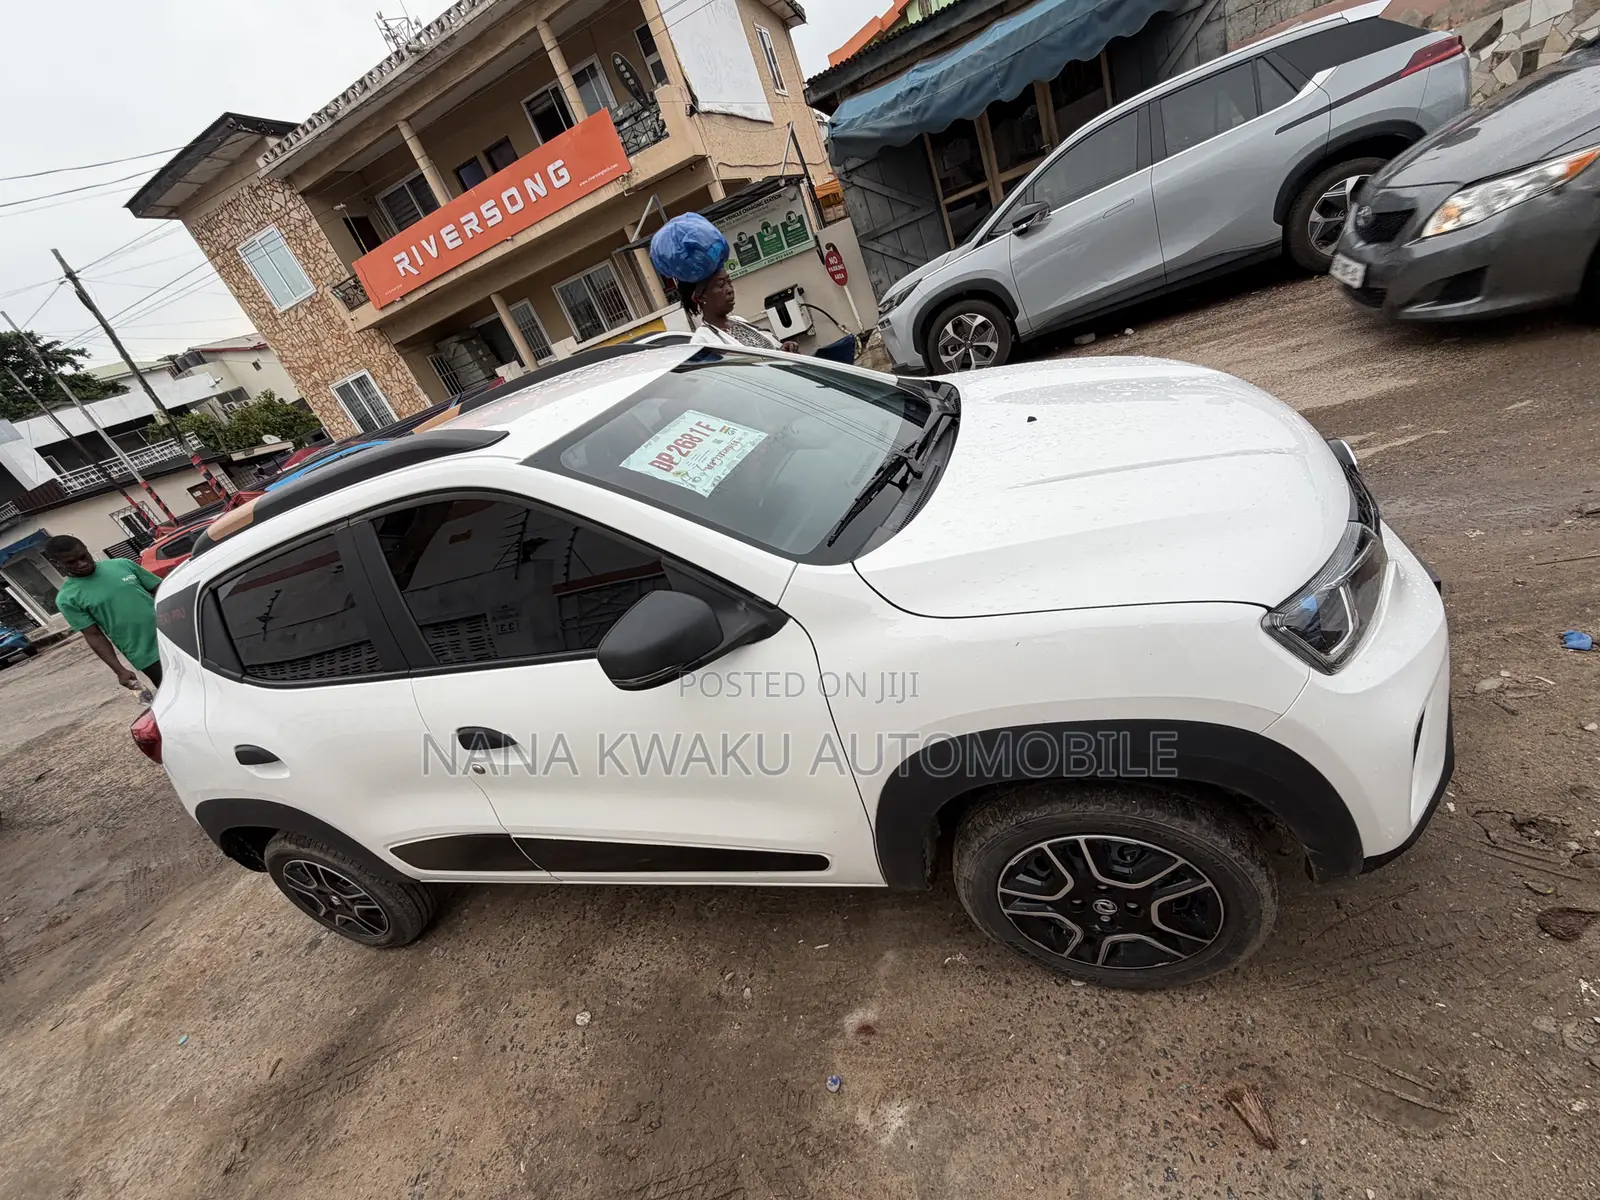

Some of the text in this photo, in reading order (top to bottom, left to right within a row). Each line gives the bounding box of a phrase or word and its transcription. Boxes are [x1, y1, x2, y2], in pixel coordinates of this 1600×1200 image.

[764, 194, 782, 205] STATION
[393, 158, 571, 277] RIVERSONG
[828, 256, 838, 265] NO
